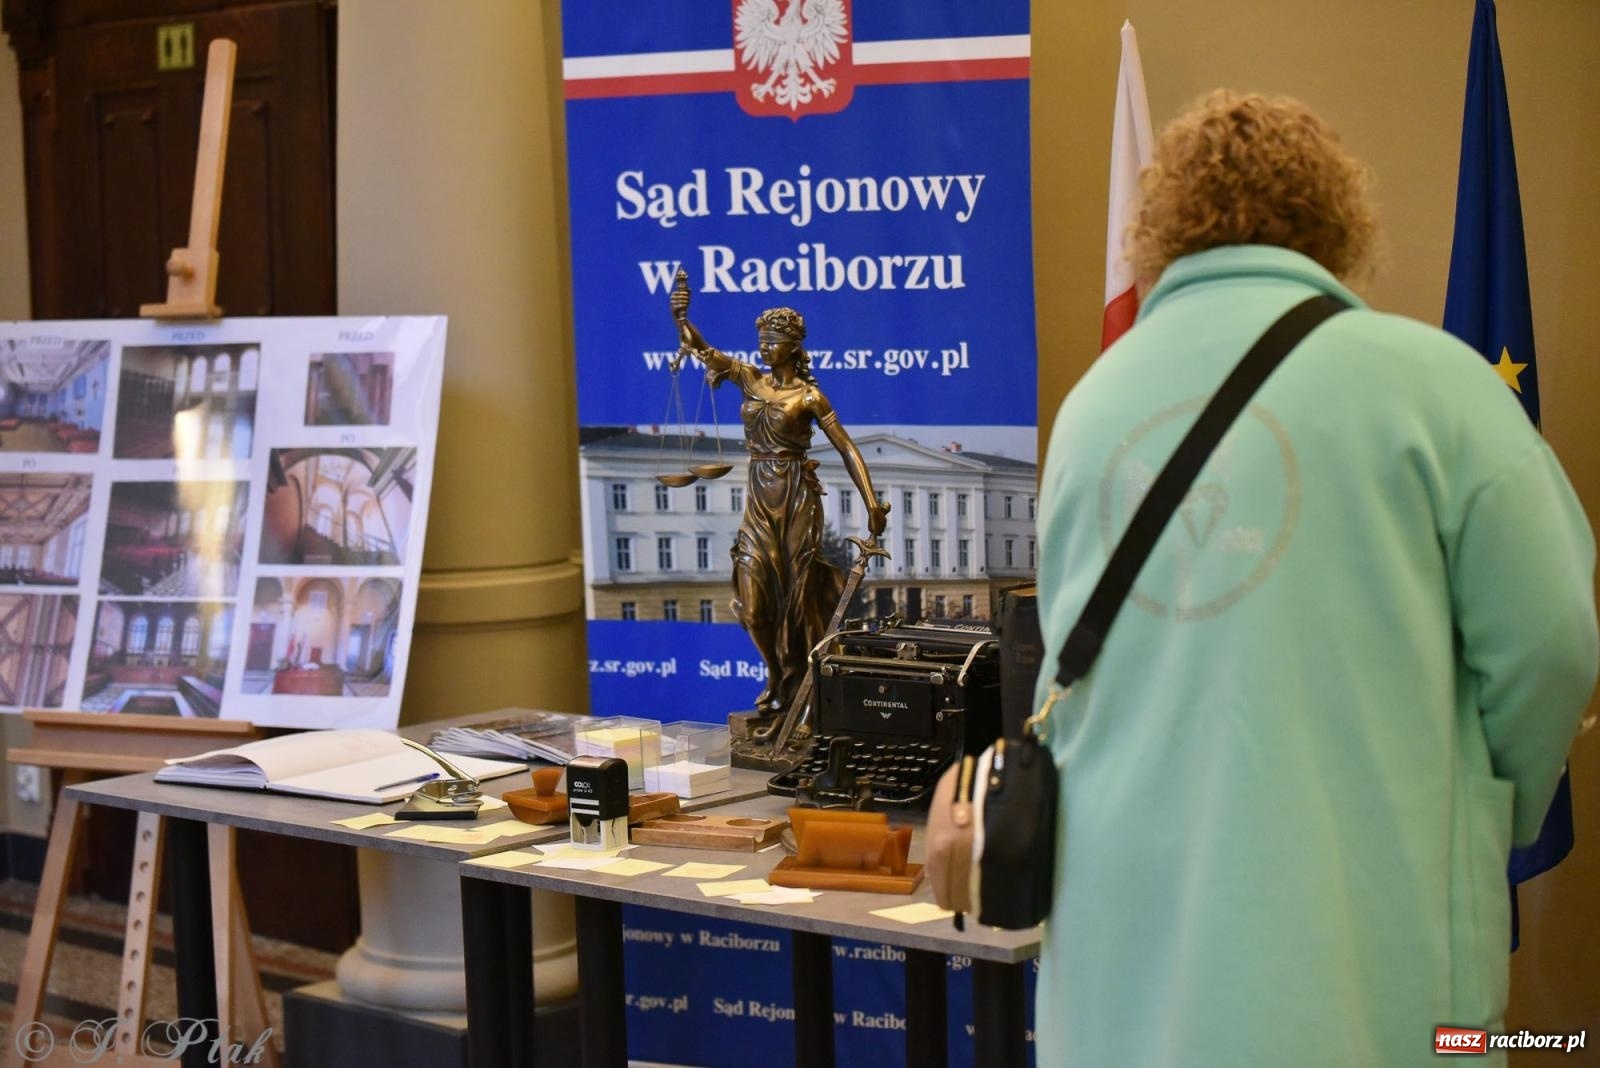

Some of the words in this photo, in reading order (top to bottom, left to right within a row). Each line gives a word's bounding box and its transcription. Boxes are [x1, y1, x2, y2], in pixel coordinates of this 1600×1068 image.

[616, 169, 710, 228] Sąd
[725, 165, 986, 228] Rejonowy
[638, 261, 681, 295] w
[699, 243, 966, 294] Raciborzu
[699, 660, 732, 680] Sąd
[863, 699, 909, 709] CONTINENTAL
[680, 932, 694, 944] w
[699, 930, 781, 952] Raciborzu
[713, 998, 745, 1017] Sąd
[833, 1012, 847, 1024] w
